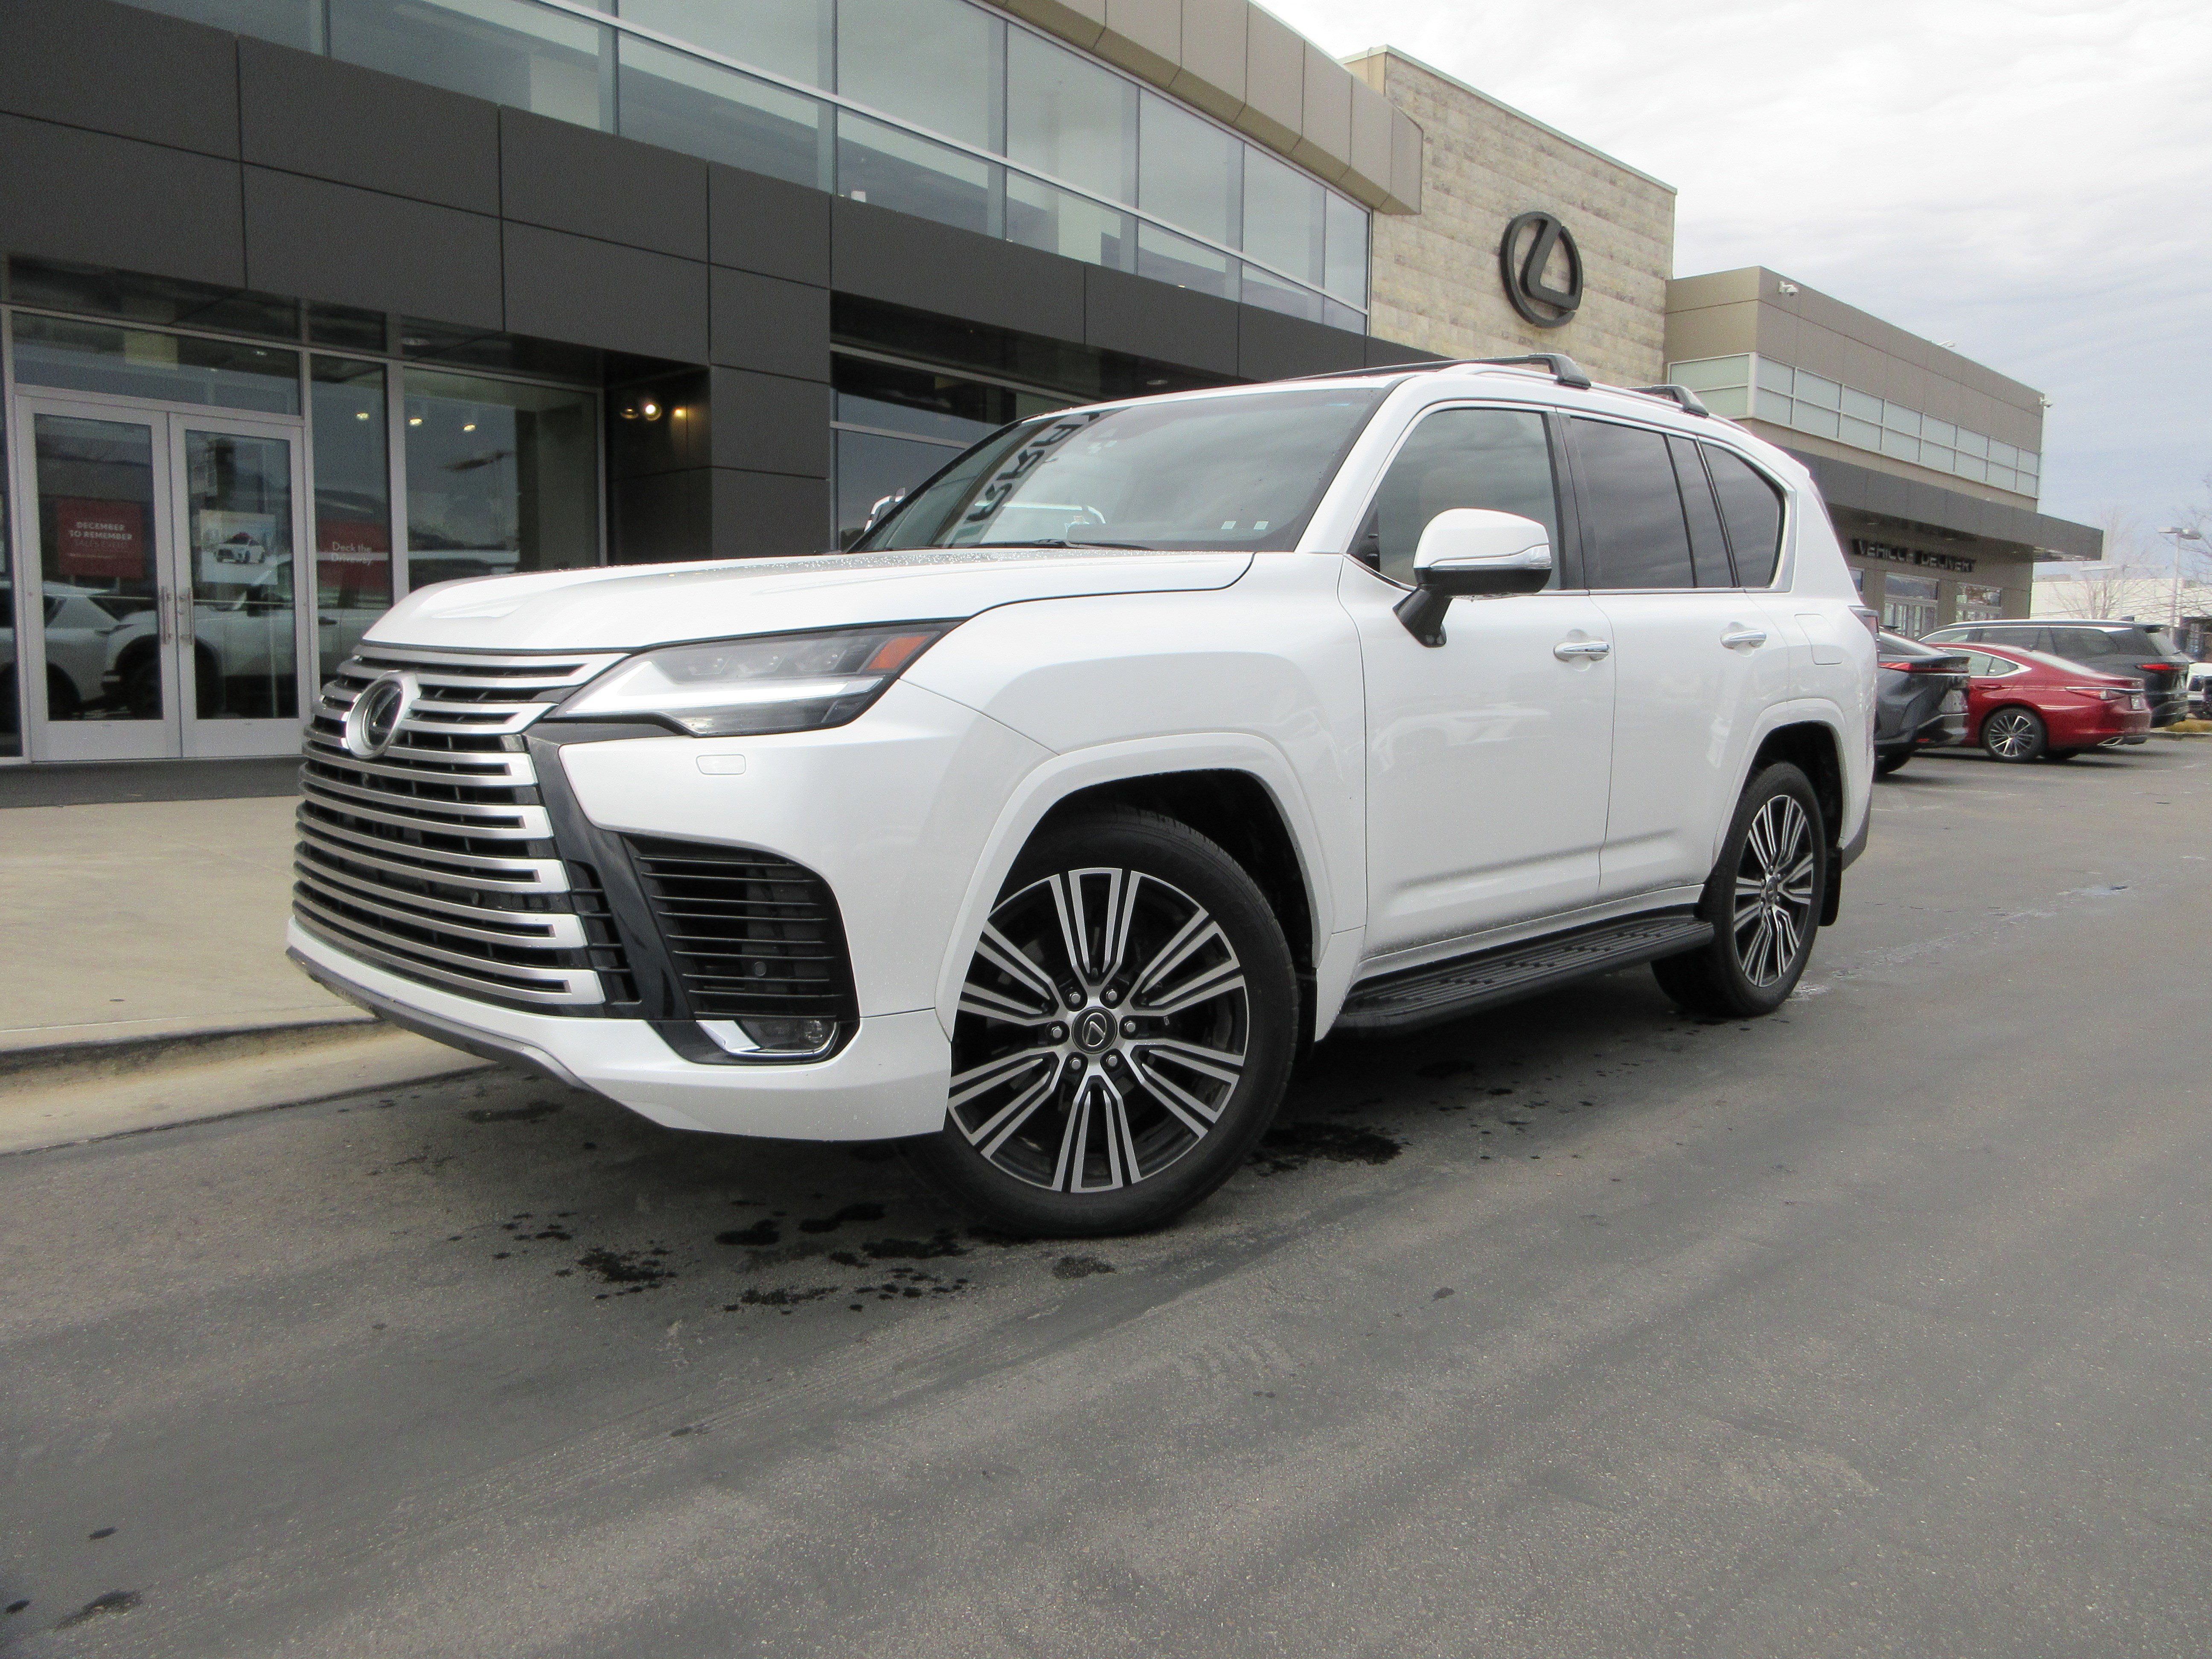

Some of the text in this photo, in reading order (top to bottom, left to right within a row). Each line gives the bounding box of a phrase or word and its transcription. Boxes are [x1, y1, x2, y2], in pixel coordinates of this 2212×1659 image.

[76, 521, 125, 531] DECEMBER
[83, 531, 132, 540] REMEMBER
[332, 541, 372, 553] Deck the
[1921, 552, 1976, 572] DELIVERY
